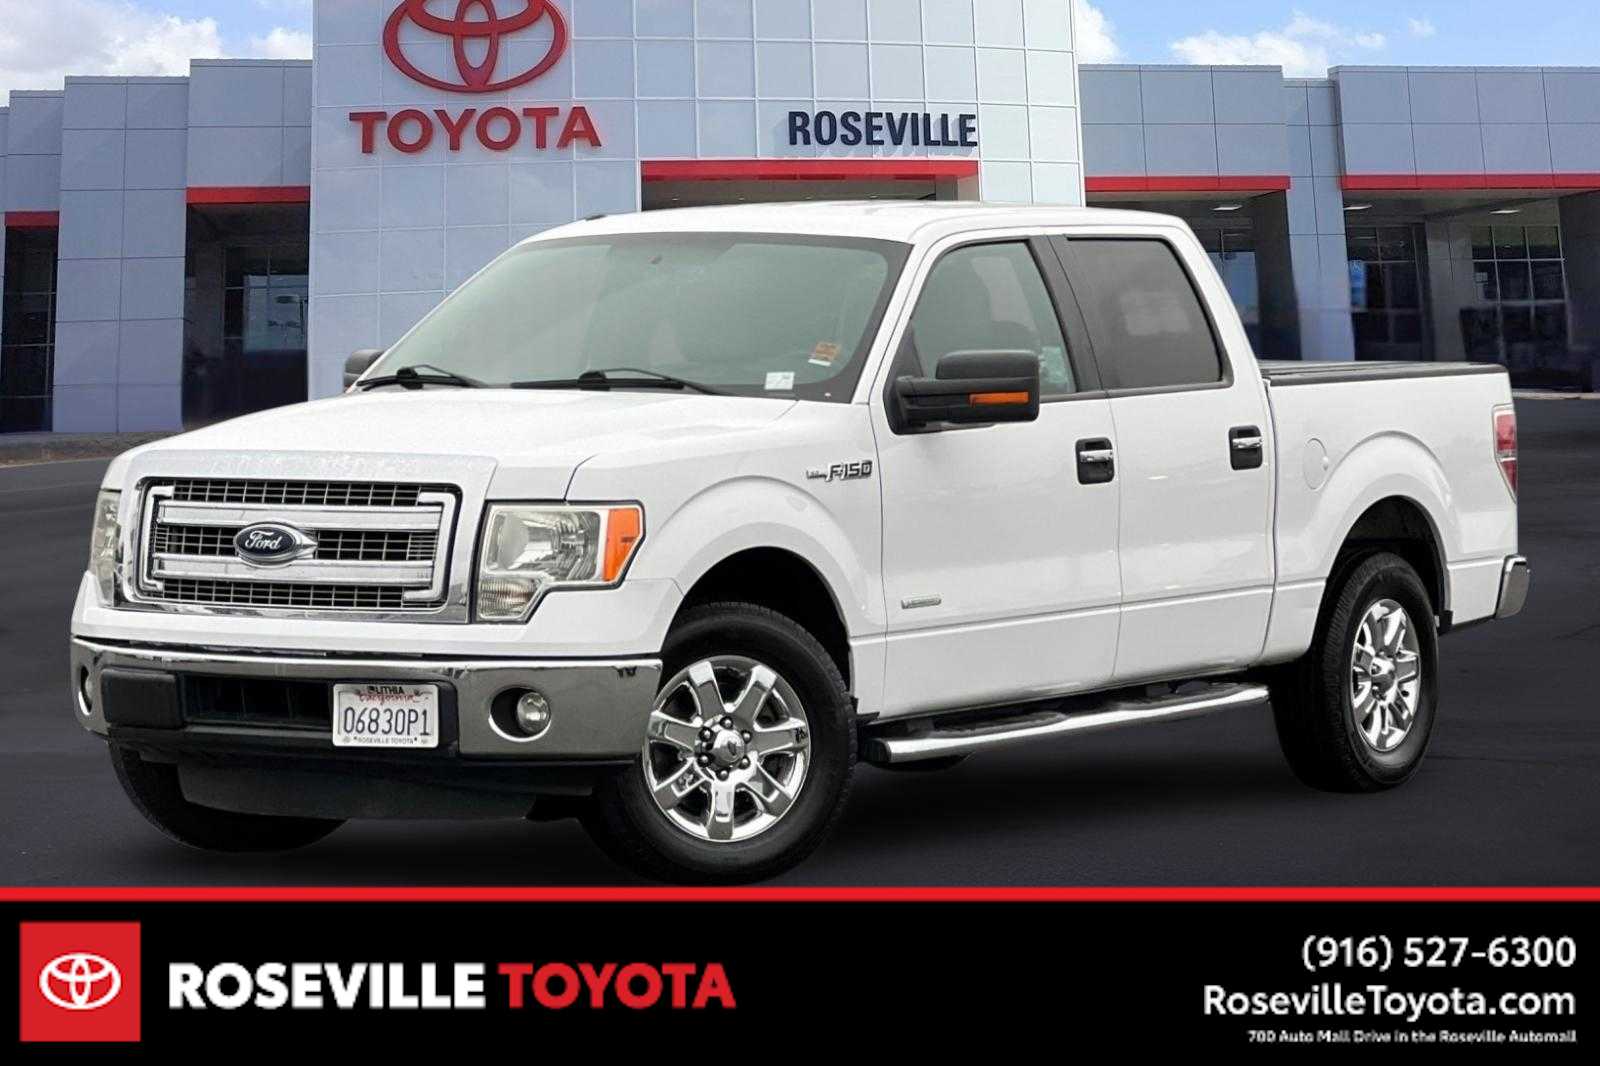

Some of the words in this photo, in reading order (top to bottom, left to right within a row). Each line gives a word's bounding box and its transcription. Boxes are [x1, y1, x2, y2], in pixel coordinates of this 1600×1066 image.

[350, 106, 603, 154] TOYOTA
[788, 110, 978, 147] ROSEVILLE
[824, 460, 873, 482] F-150
[245, 530, 283, 550] Ford
[343, 706, 432, 736] 06830P1
